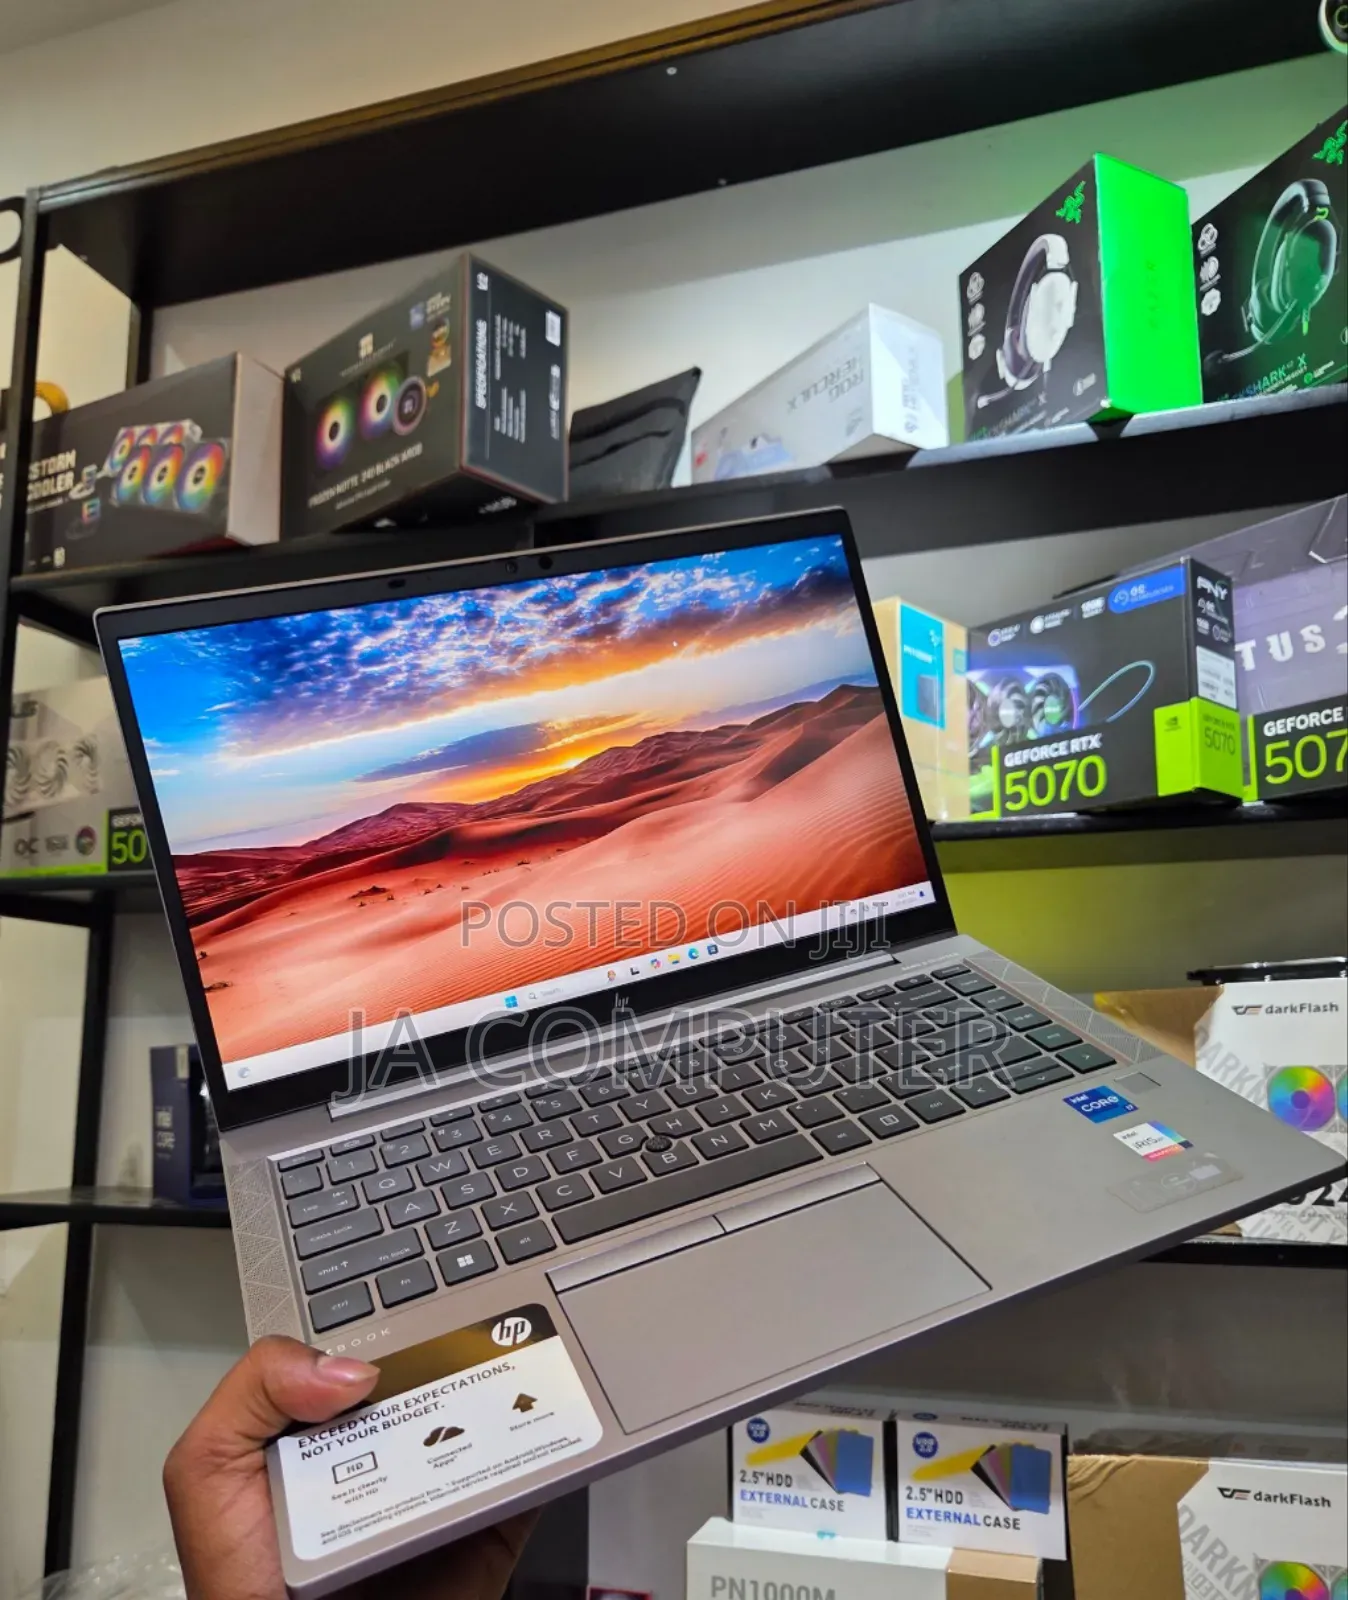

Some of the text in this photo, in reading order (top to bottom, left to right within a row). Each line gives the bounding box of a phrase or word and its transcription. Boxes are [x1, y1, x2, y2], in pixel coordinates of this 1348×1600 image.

[29, 449, 76, 480] STORM
[1197, 576, 1227, 600] PNY
[1263, 706, 1344, 737] GEFORCE
[1204, 726, 1236, 756] 5070
[1004, 733, 1102, 767] GEFORCE RTX
[1265, 728, 1348, 784] 507
[1005, 755, 1107, 811] 5070
[112, 829, 147, 864] 50
[1265, 1002, 1339, 1015] darkFlash
[761, 1089, 777, 1100] K
[1069, 1094, 1089, 1104] intel
[636, 1099, 648, 1109] Y
[719, 1104, 729, 1114] J
[588, 1115, 602, 1124] T
[666, 1119, 682, 1130] H
[759, 1119, 778, 1131] M
[537, 1130, 553, 1140] R
[618, 1135, 634, 1144] G
[711, 1135, 728, 1146] N
[487, 1145, 501, 1156] E
[566, 1150, 579, 1161] F
[661, 1152, 677, 1163] B
[429, 1160, 452, 1173] W
[513, 1167, 528, 1178] D
[608, 1167, 623, 1178] V
[379, 1178, 397, 1189] Q
[460, 1183, 474, 1195] S
[556, 1185, 573, 1196] C
[405, 1202, 421, 1214] A
[501, 1203, 517, 1215] X
[444, 1220, 461, 1235] Z
[497, 1316, 529, 1346] hp
[298, 1361, 516, 1448] EXCEED YOUR EXPECTATIONS,
[301, 1401, 445, 1460] NOT YOUR BUDGET.
[346, 1462, 363, 1474] HD
[740, 1489, 845, 1512] EXTERNAL CASE
[1253, 1491, 1332, 1508] darkFlash
[906, 1507, 1021, 1530] EXTERNAL CASE
[711, 1575, 835, 1600] PN1000M
